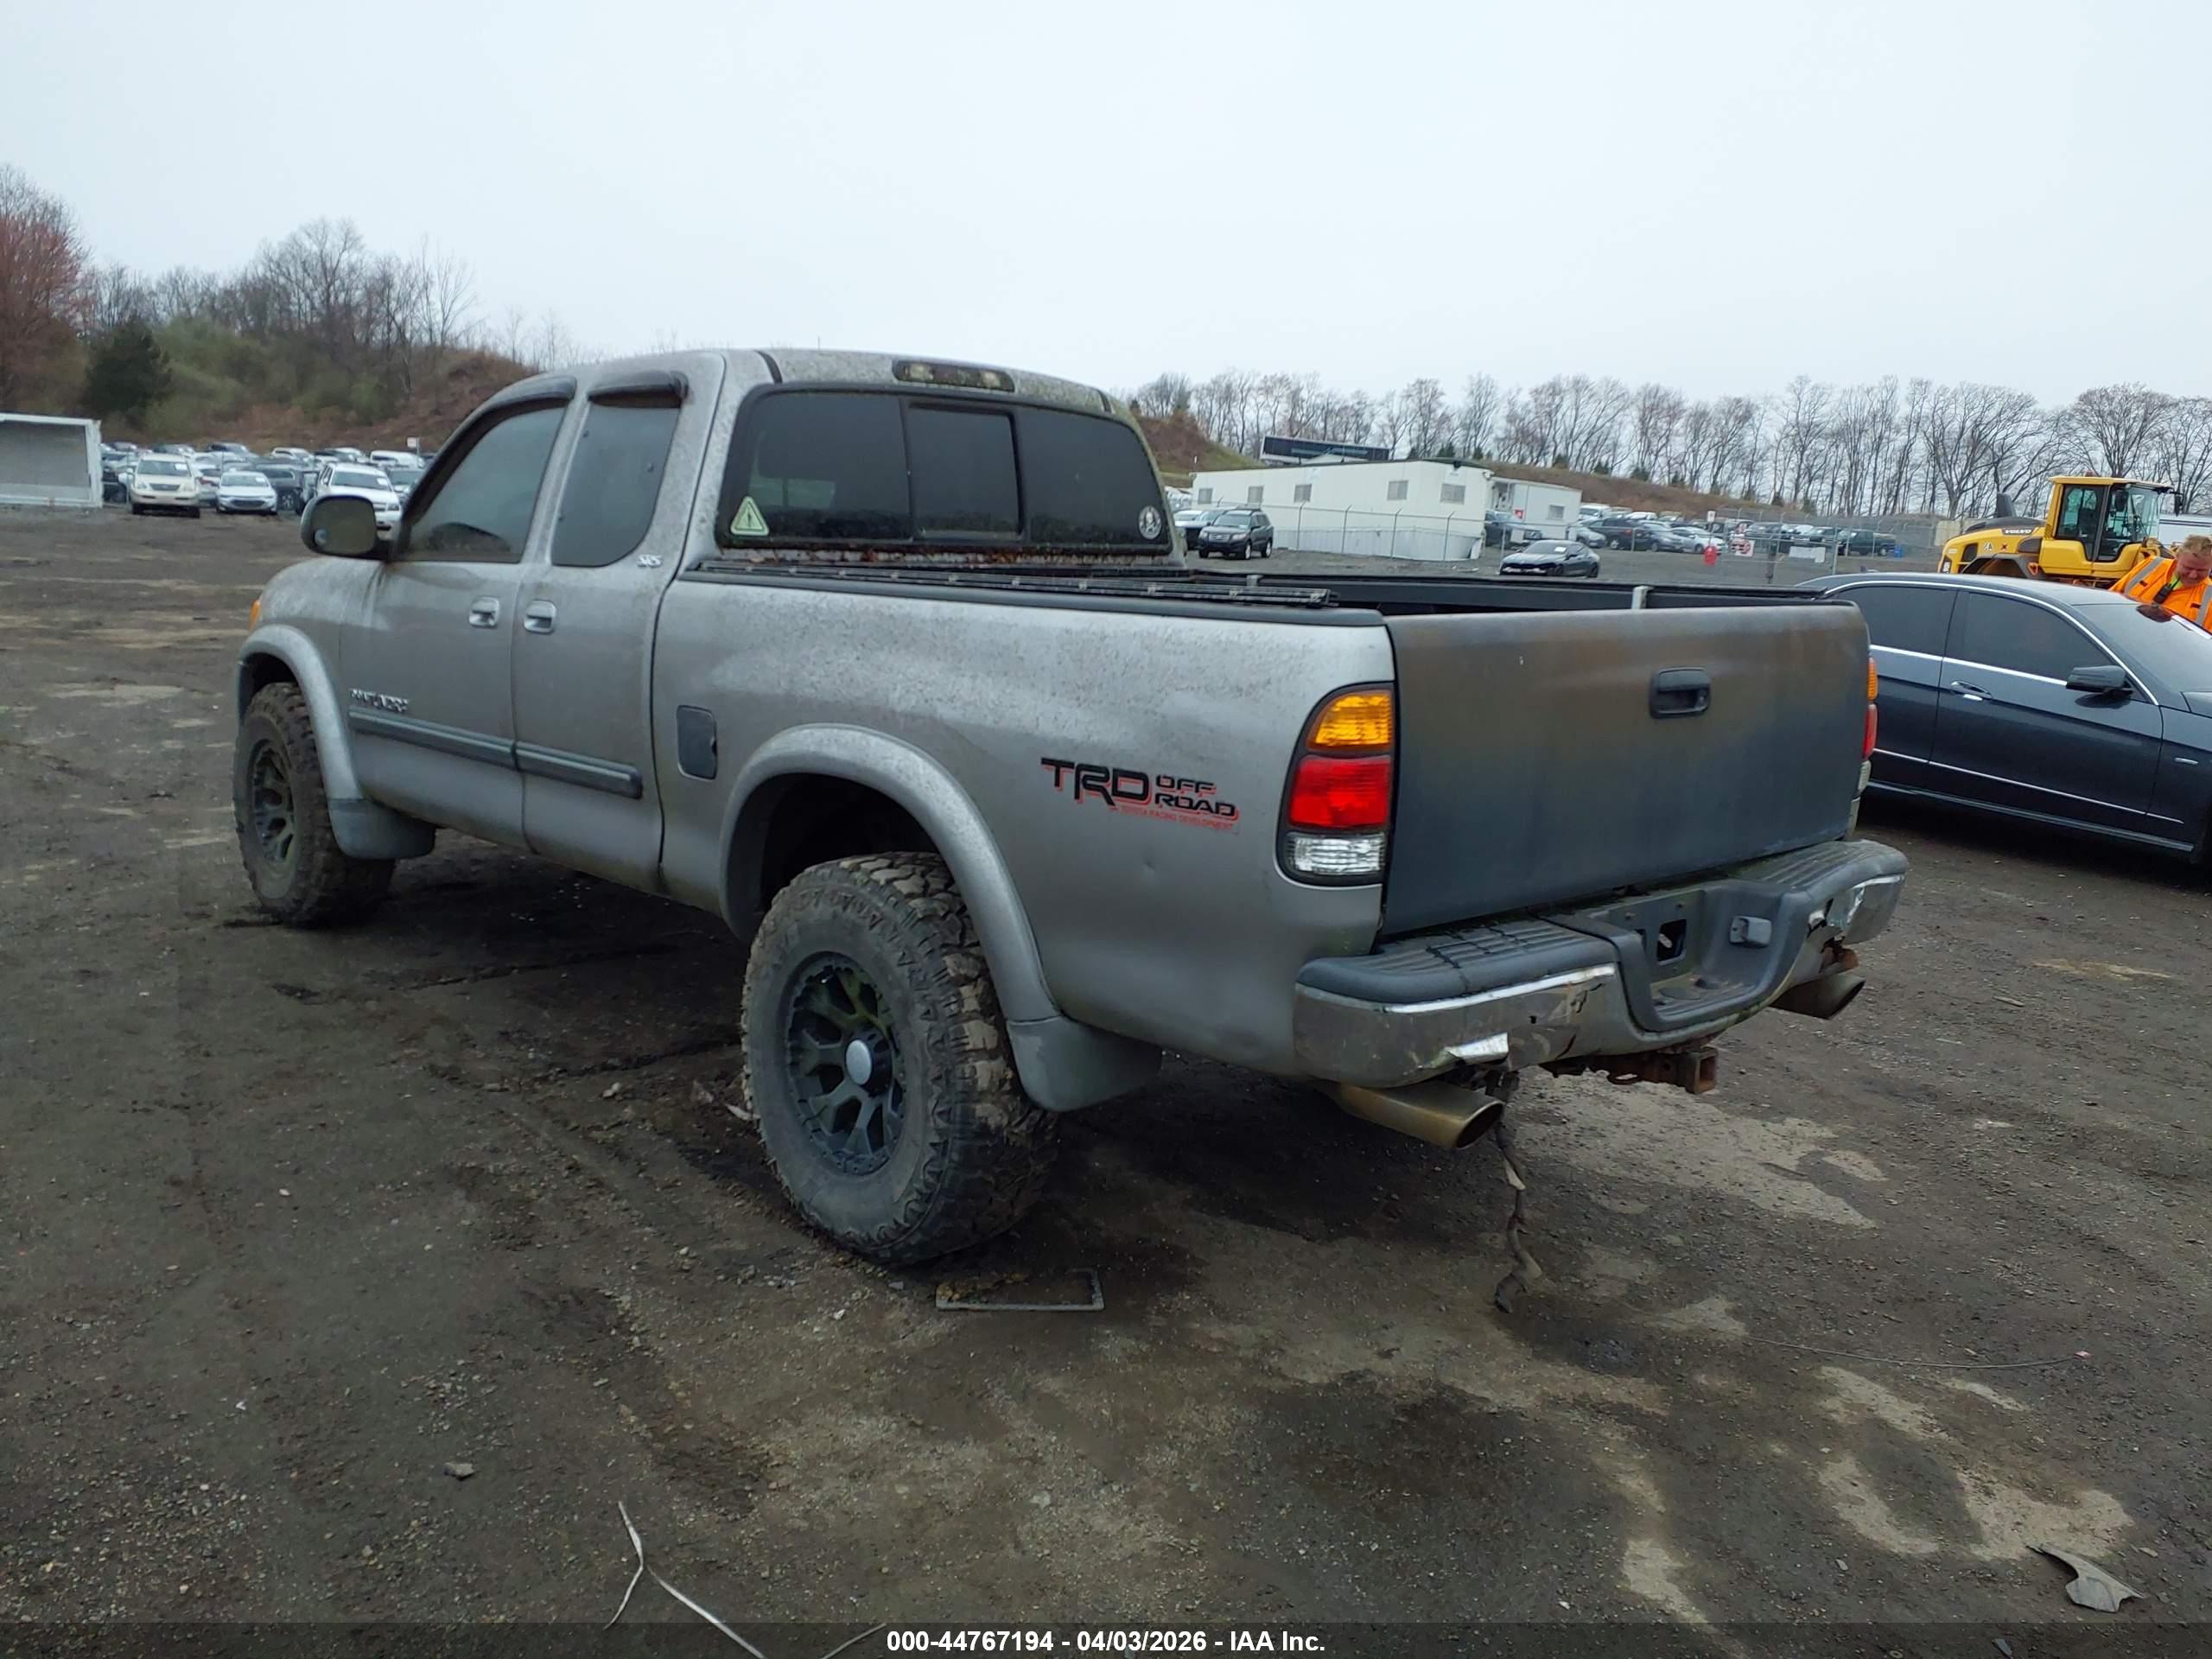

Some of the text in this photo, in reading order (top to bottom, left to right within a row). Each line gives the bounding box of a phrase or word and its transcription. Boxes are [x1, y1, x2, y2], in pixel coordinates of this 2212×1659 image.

[1040, 758, 1215, 806] TRD OFF
[1154, 792, 1237, 817] ROAD
